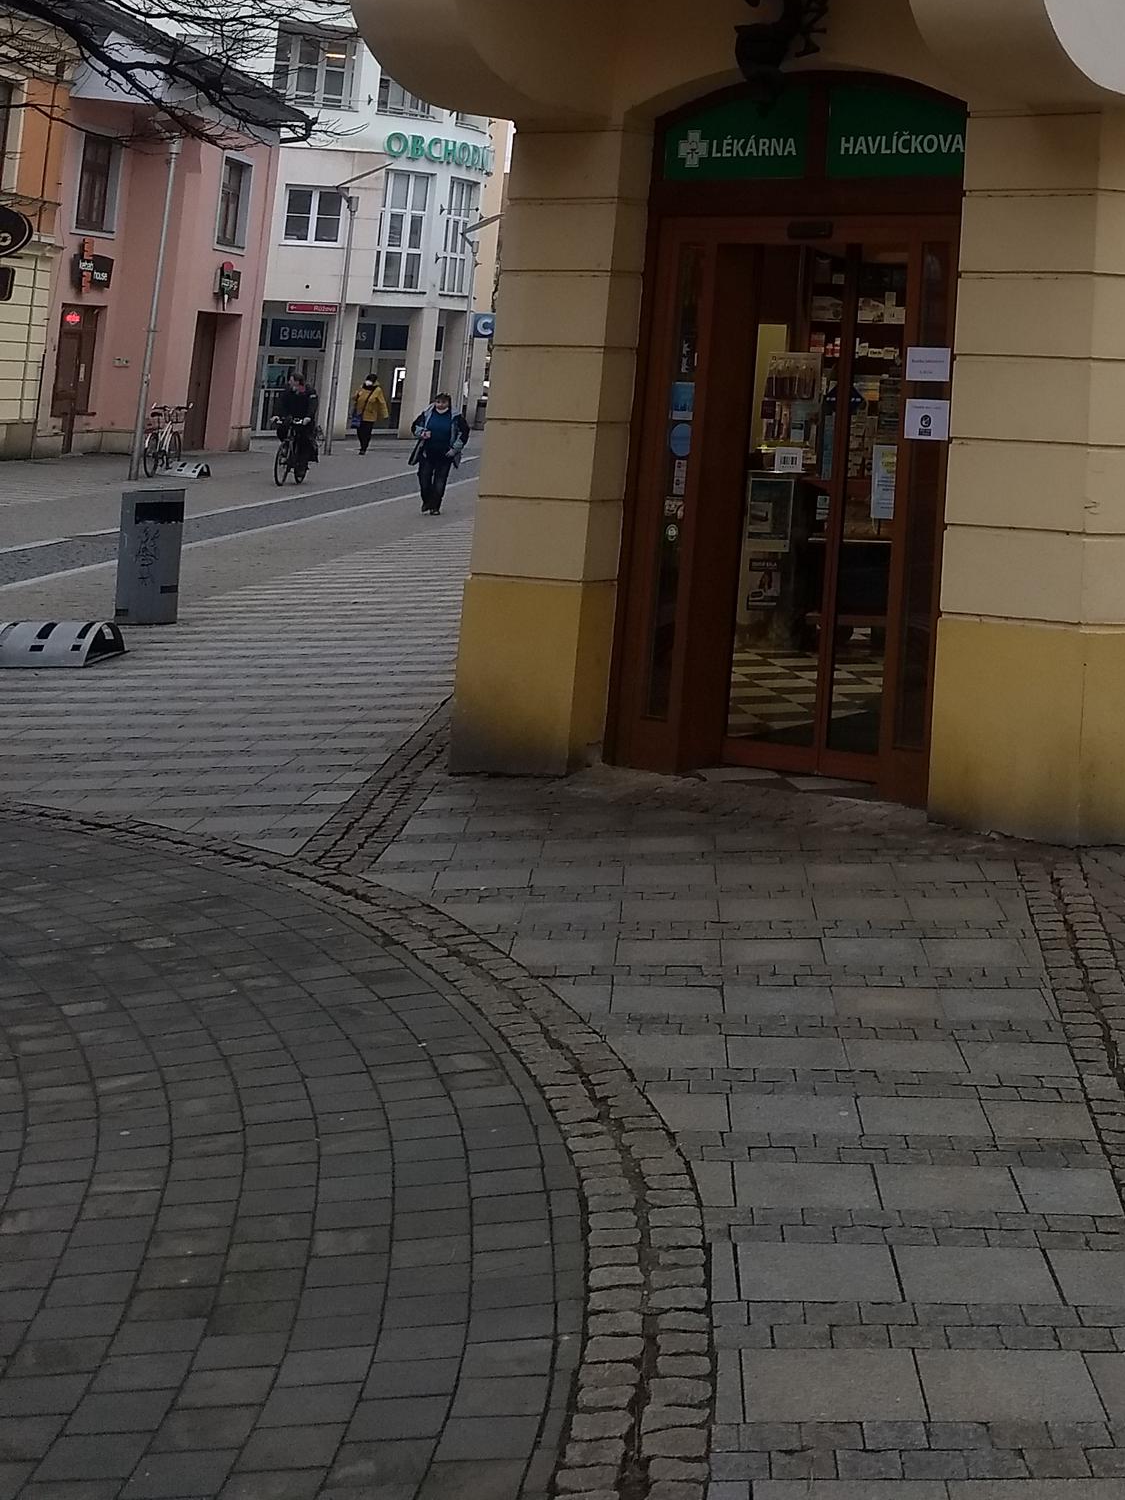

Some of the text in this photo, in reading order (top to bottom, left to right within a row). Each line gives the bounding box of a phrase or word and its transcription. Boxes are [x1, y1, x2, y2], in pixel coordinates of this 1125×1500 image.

[712, 131, 965, 158] LÉKÁRNA HAVLÍČKOVA
[291, 328, 322, 340] BANKA
